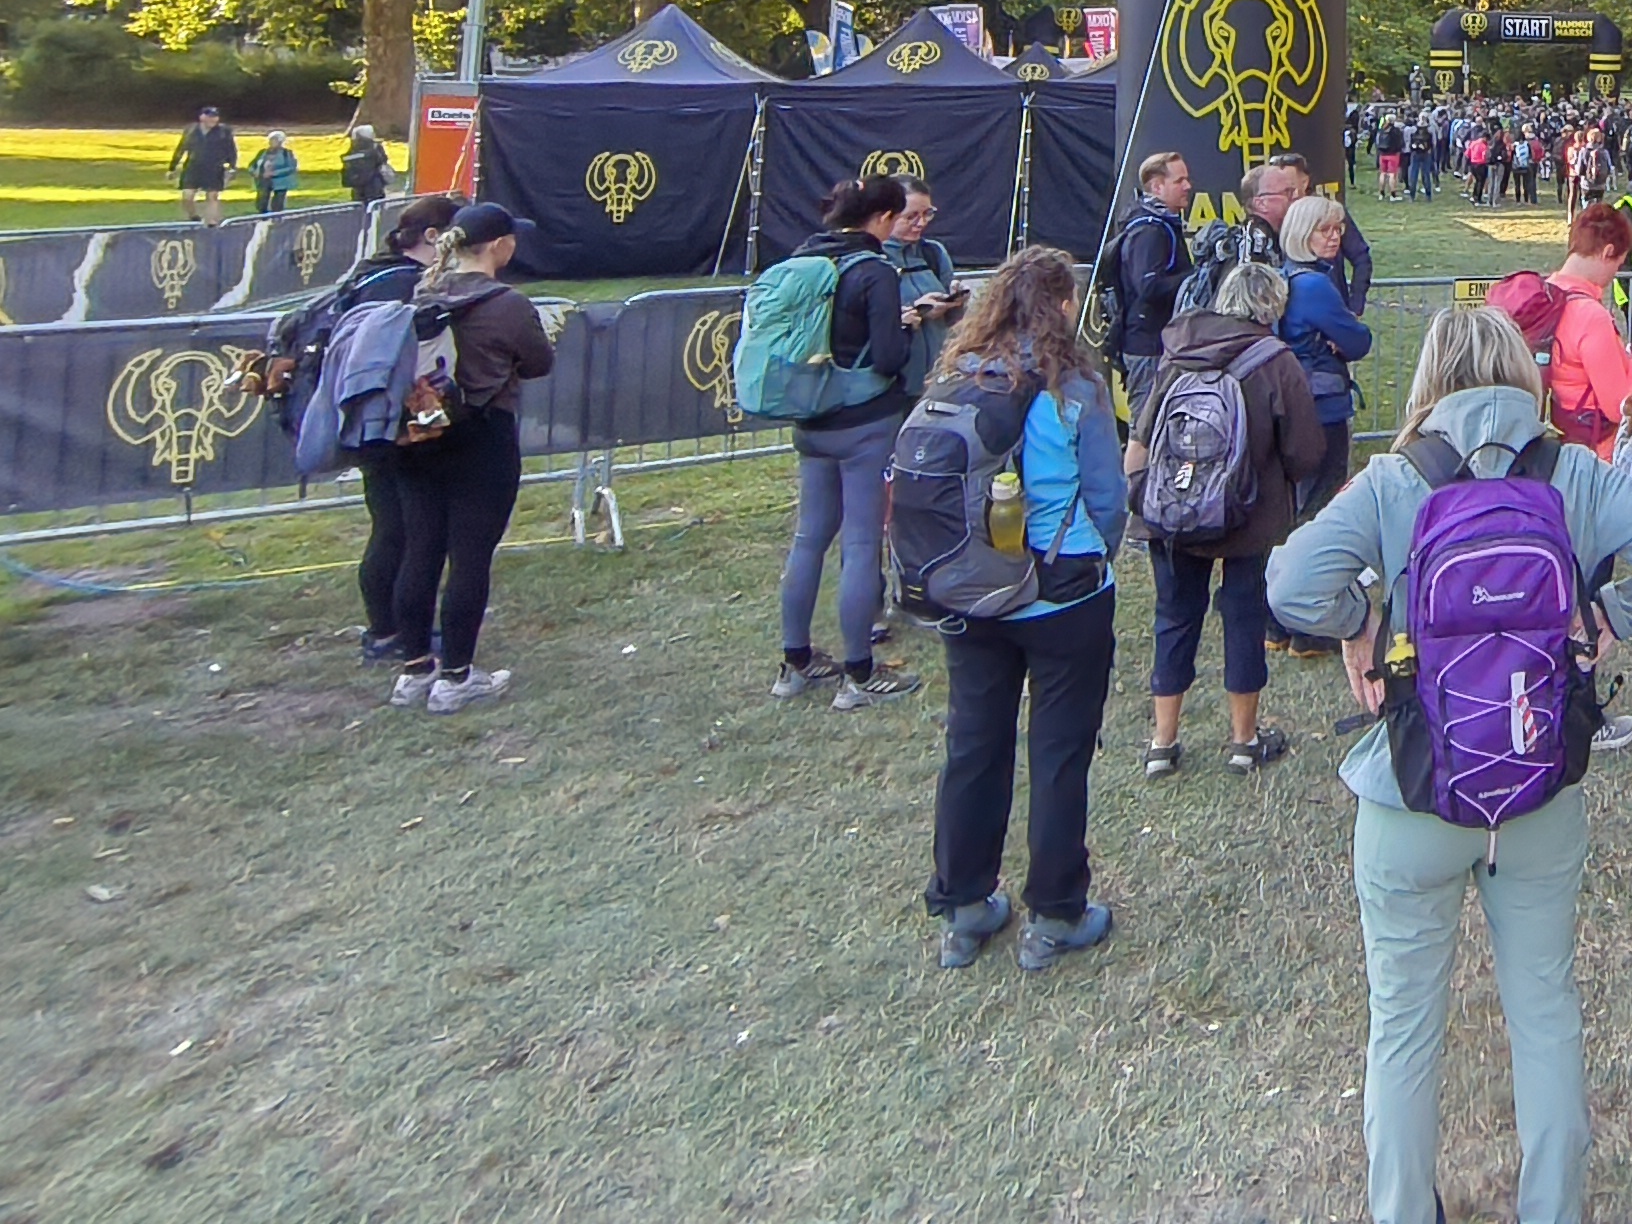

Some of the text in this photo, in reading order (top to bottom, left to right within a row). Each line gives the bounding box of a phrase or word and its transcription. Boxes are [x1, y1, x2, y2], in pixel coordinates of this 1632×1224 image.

[1505, 19, 1549, 36] START
[1553, 20, 1594, 29] MAMMUT
[1555, 29, 1593, 37] MARSCH
